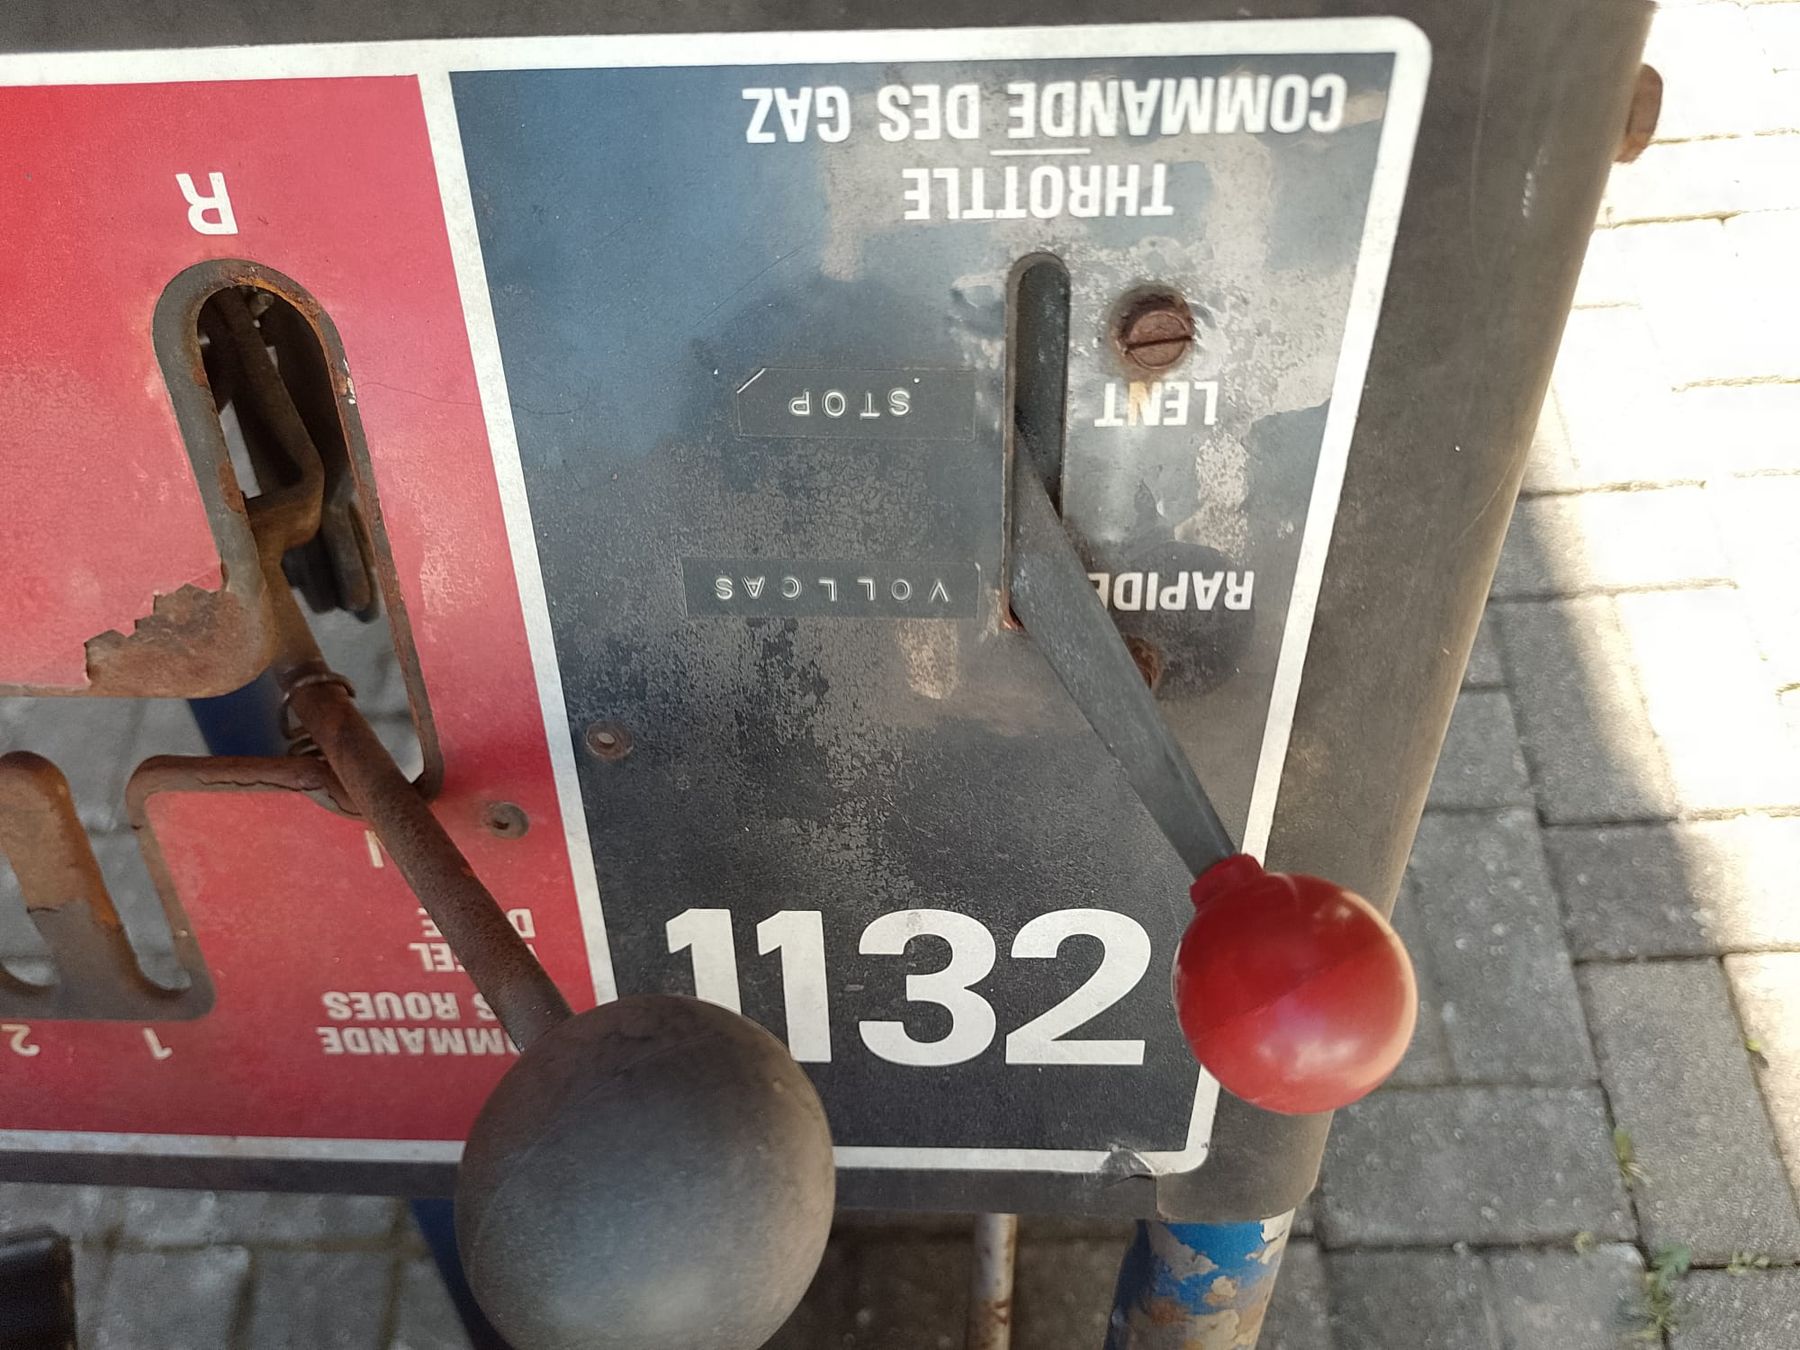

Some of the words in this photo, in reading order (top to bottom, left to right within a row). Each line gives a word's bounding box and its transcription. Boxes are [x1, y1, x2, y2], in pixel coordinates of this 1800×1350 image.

[741, 86, 851, 144] GAZ
[877, 83, 980, 141] DES
[1008, 73, 1348, 138] COMMANDE
[175, 172, 239, 235] R
[902, 163, 1174, 220] THROTTLE
[789, 389, 911, 420] STOP
[1095, 381, 1218, 427] LENT
[322, 991, 461, 1021] ROUES
[666, 908, 1152, 1066] 1132
[1, 1023, 40, 1057] 2
[143, 1027, 173, 1060] 1
[317, 1026, 522, 1055] MMANDE
